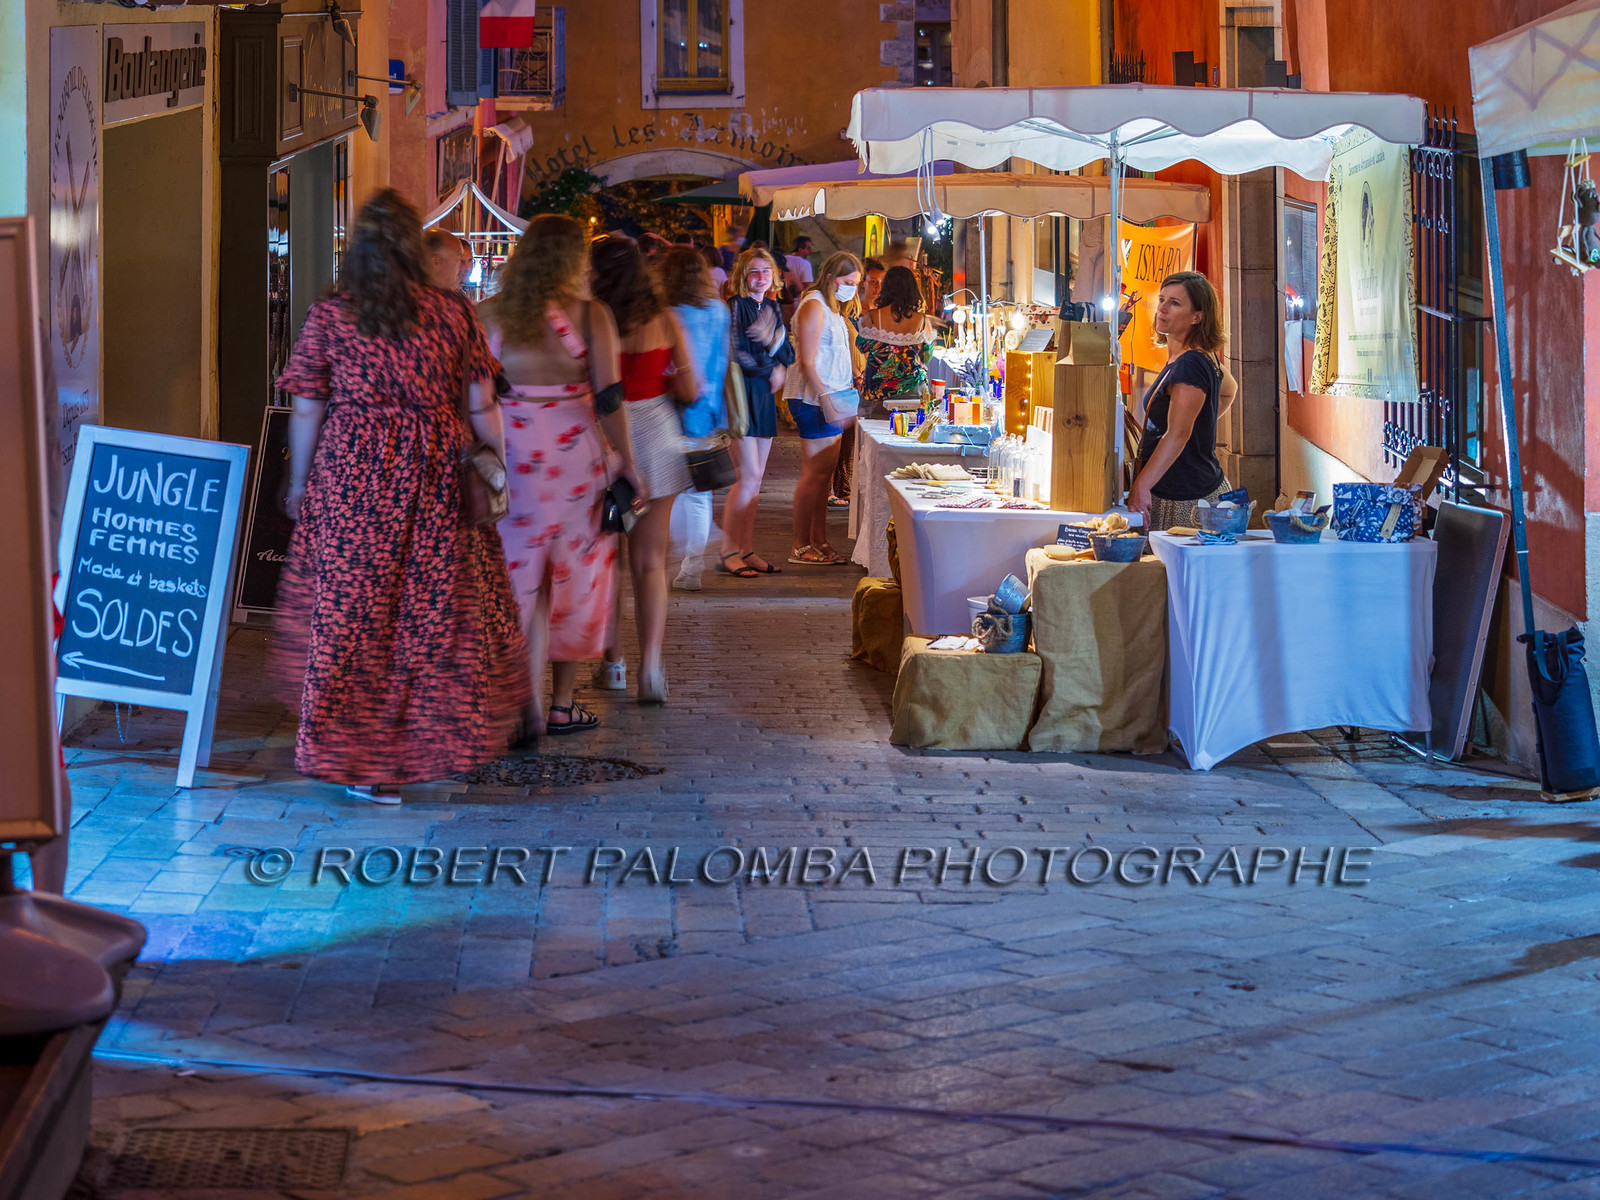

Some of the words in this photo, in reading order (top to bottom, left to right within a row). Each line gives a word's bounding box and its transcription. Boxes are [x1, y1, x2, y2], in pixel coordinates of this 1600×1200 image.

[105, 32, 206, 108] Boulangerie
[525, 135, 597, 181] Hôtel
[93, 454, 220, 513] JUNGLE
[89, 529, 200, 565] FEMMES
[92, 507, 198, 543] HOMMES
[78, 556, 125, 580] Mode
[126, 569, 141, 587] et
[149, 572, 208, 598] baskets
[71, 588, 198, 658] SOLDES
